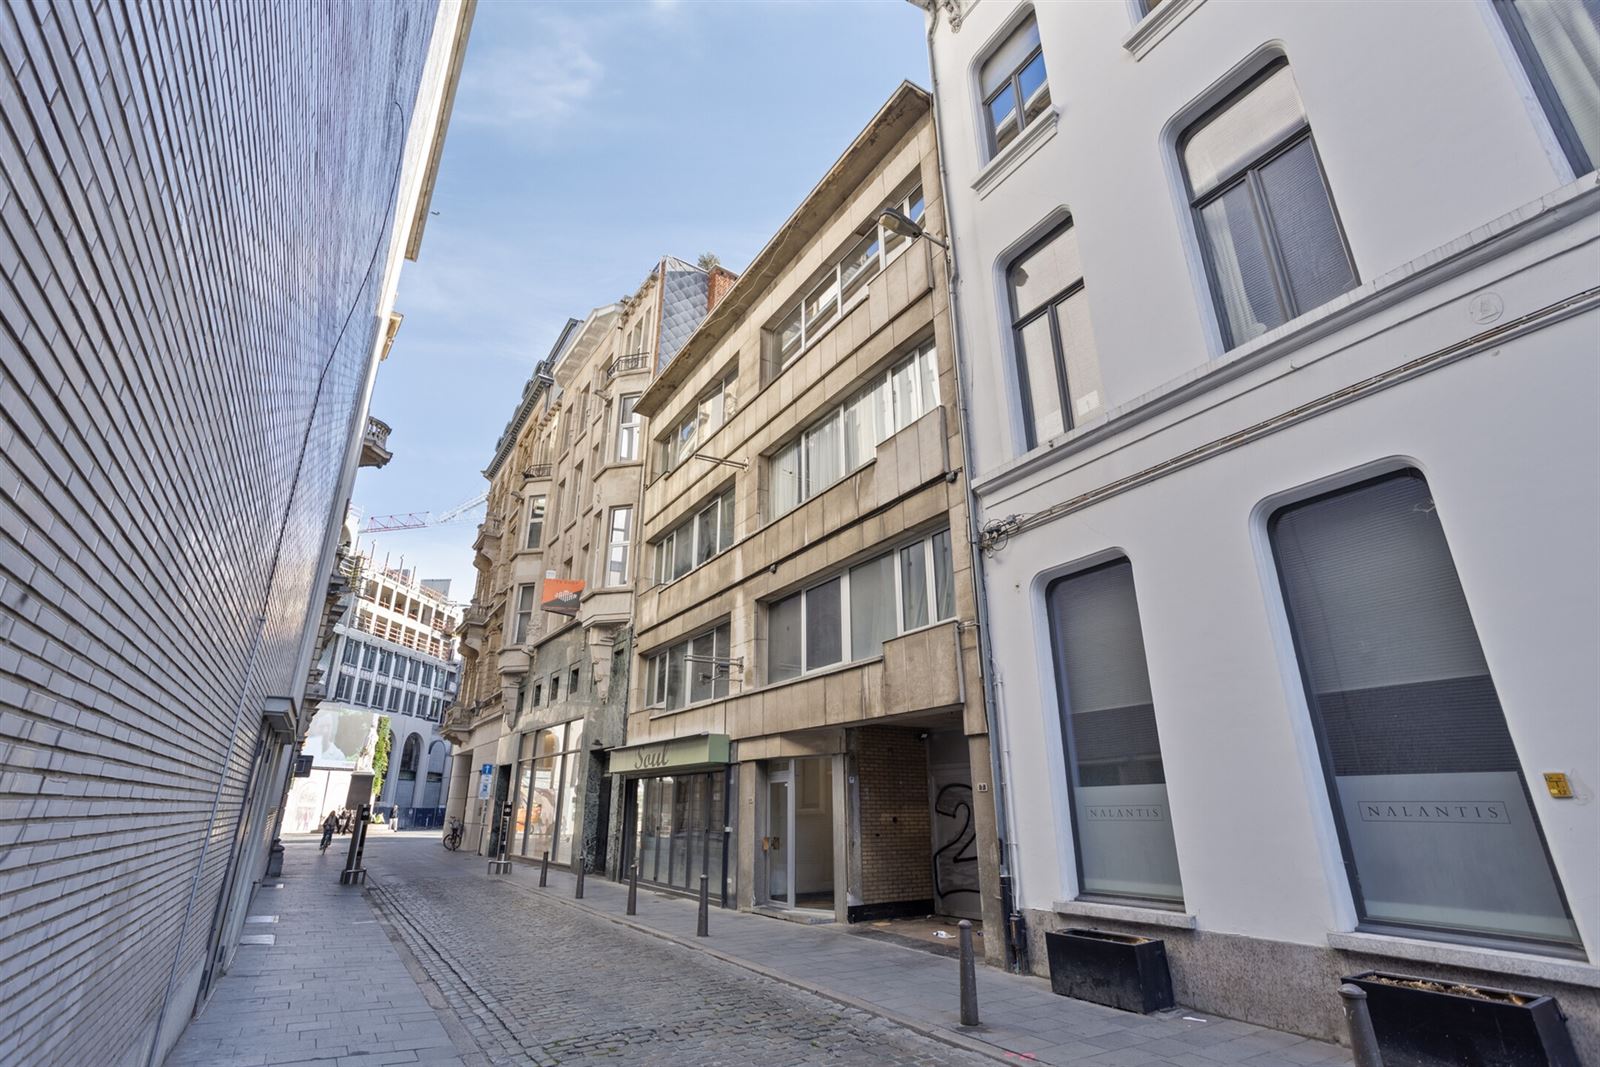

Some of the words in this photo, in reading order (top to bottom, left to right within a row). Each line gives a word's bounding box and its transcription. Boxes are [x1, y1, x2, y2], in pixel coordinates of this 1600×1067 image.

[634, 742, 671, 770] Soul
[1089, 808, 1160, 818] NALANTIS
[1367, 805, 1499, 819] NALANTIS
